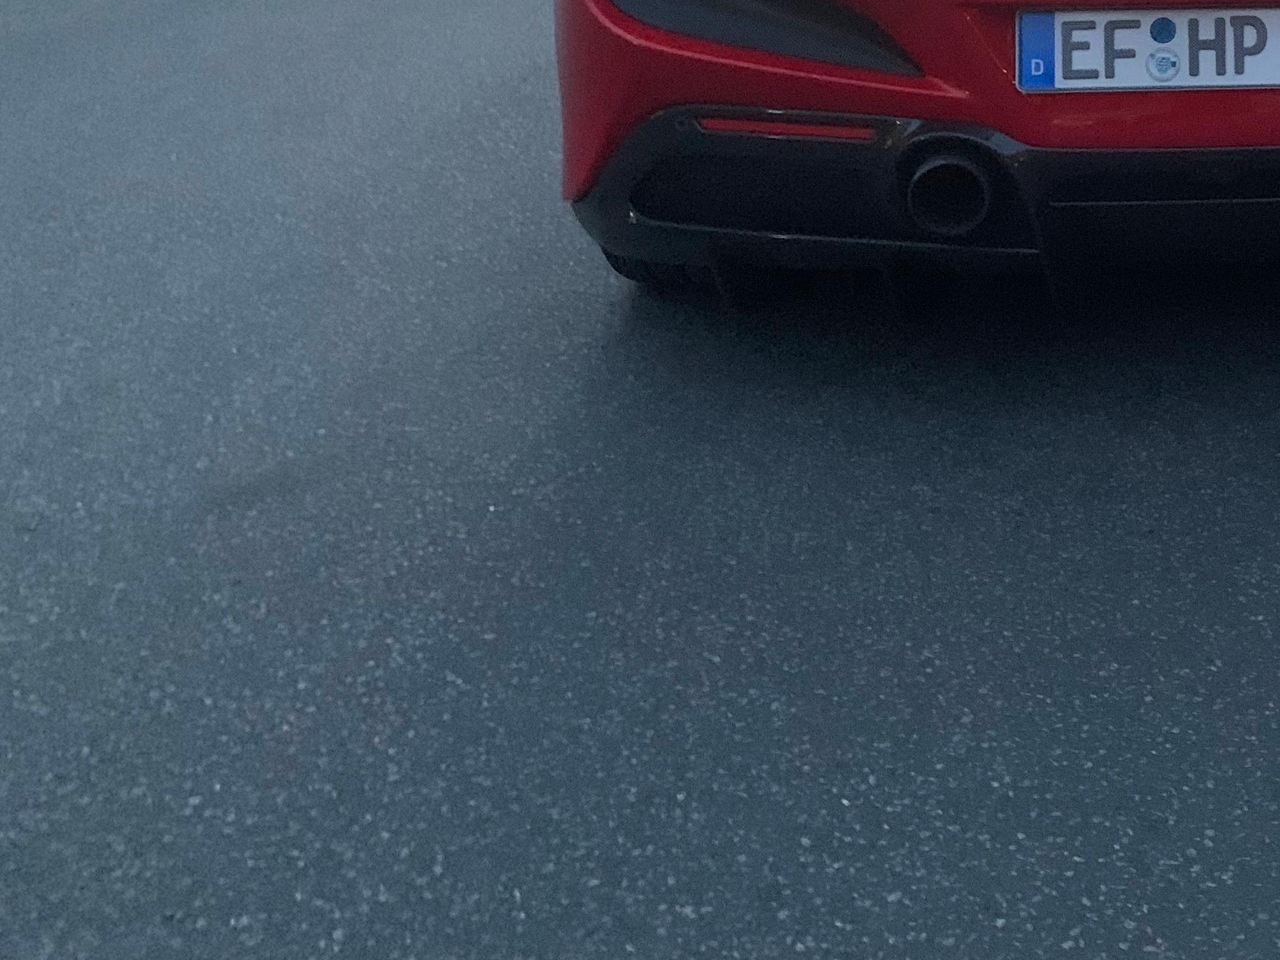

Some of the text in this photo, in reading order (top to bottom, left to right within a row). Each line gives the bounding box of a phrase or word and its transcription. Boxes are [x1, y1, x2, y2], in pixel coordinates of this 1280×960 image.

[1030, 59, 1044, 76] D
[1060, 19, 1142, 80] EF
[1187, 16, 1268, 76] HP
